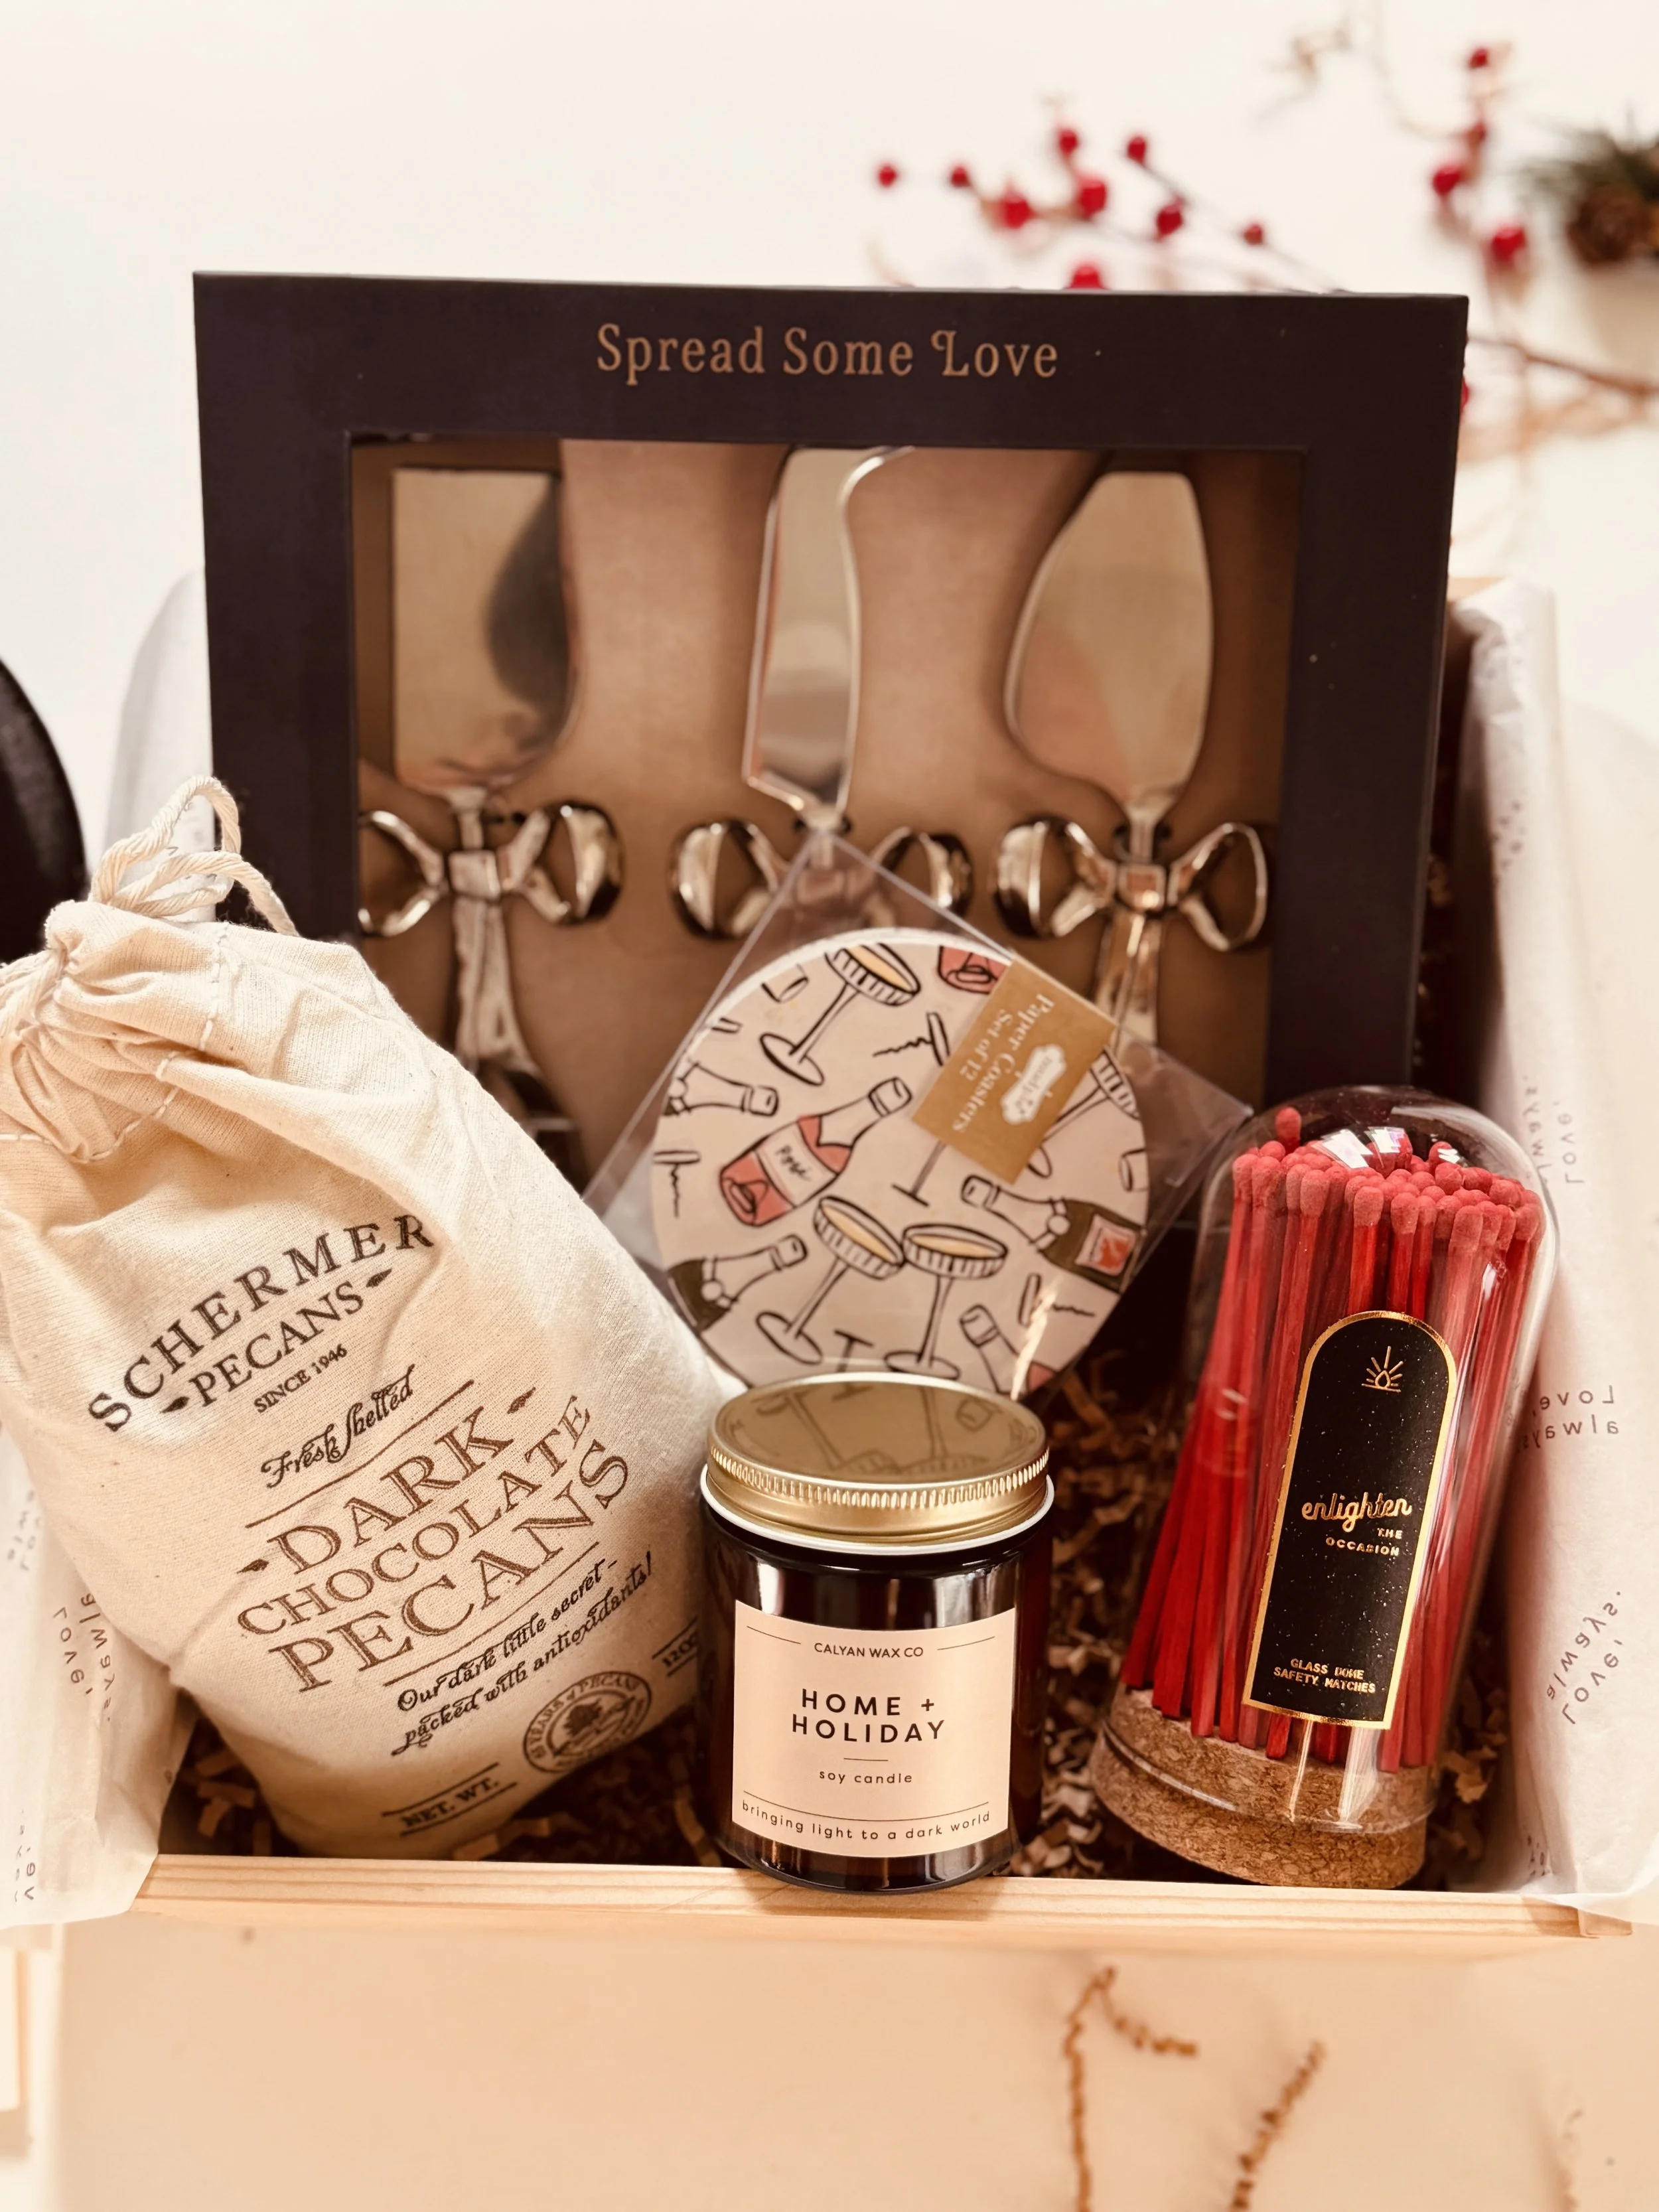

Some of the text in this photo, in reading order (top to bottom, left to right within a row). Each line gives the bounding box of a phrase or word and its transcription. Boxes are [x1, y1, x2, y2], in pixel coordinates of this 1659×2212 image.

[597, 323, 1058, 386] Spread Some Love
[952, 993, 1055, 1133] Paper Coasters
[959, 1008, 1014, 1081] Set of 12
[88, 1214, 435, 1432] SCHERMER
[188, 1280, 364, 1408] PECANS
[253, 1343, 348, 1413] SINCE 1946
[261, 1363, 415, 1489] Fresh Shelled
[238, 1394, 592, 1635] CHOCOLATE
[267, 1406, 513, 1575] DARK
[1301, 1491, 1412, 1532] enlighten
[1326, 1536, 1400, 1556] OCCASION
[1376, 1527, 1404, 1540] THE
[269, 1439, 628, 1693] PECANS
[392, 1686, 484, 1756] packed
[484, 1660, 529, 1702] with
[534, 1551, 652, 1672] antioxidants!
[397, 1679, 447, 1712] Our
[443, 1646, 496, 1689] dark
[502, 1612, 547, 1659] little
[814, 1642, 924, 1659] CALYAN WAX CO
[1273, 1666, 1376, 1694] SAFETY MATCHES
[1290, 1658, 1365, 1680] GLASS DOME
[792, 1714, 945, 1743] HOLIDAY
[802, 1688, 934, 1716] HOME +
[401, 1776, 499, 1827] NET. WT.
[819, 1770, 913, 1784] soy candle
[742, 1800, 991, 1840] bringing light to a dark world
